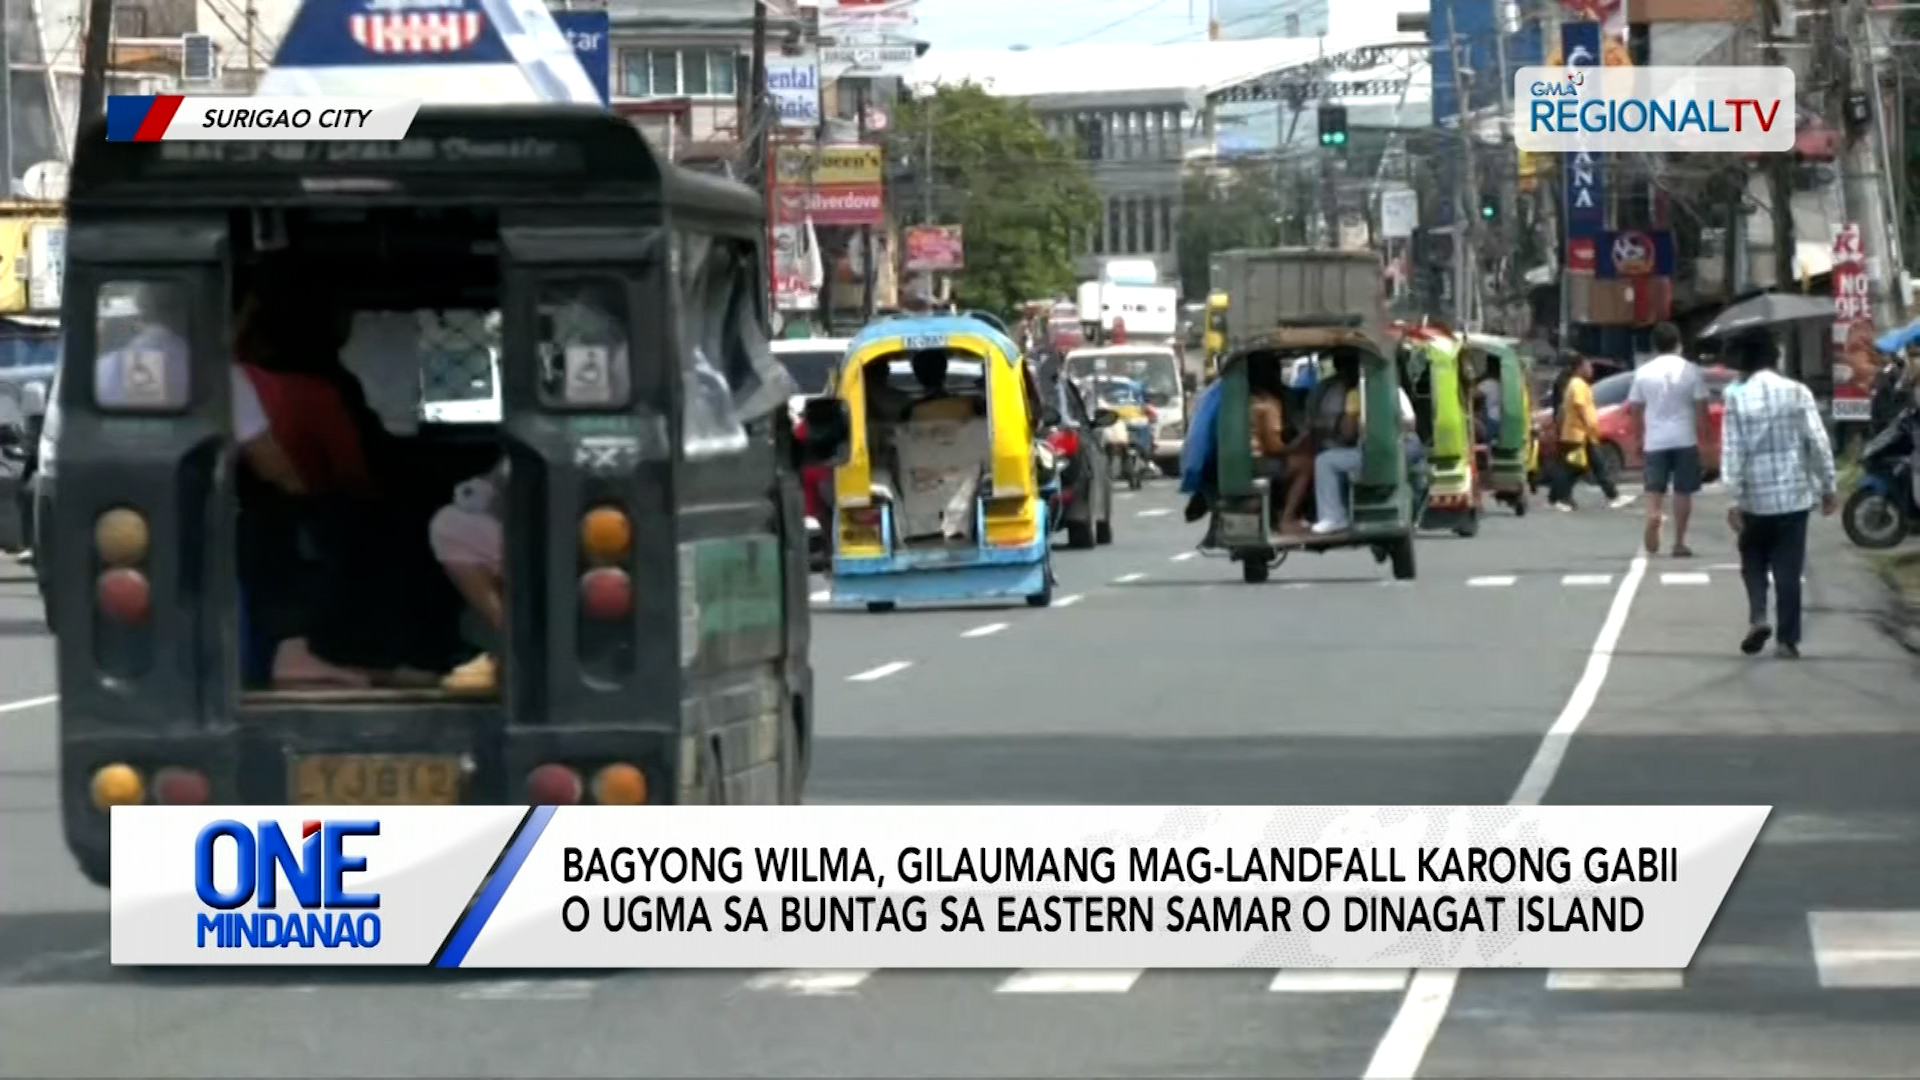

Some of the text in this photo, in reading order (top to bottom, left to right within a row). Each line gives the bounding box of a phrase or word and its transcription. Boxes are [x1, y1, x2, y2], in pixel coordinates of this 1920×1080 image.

[567, 29, 600, 50] tar
[767, 64, 815, 89] ental
[777, 96, 815, 118] inic
